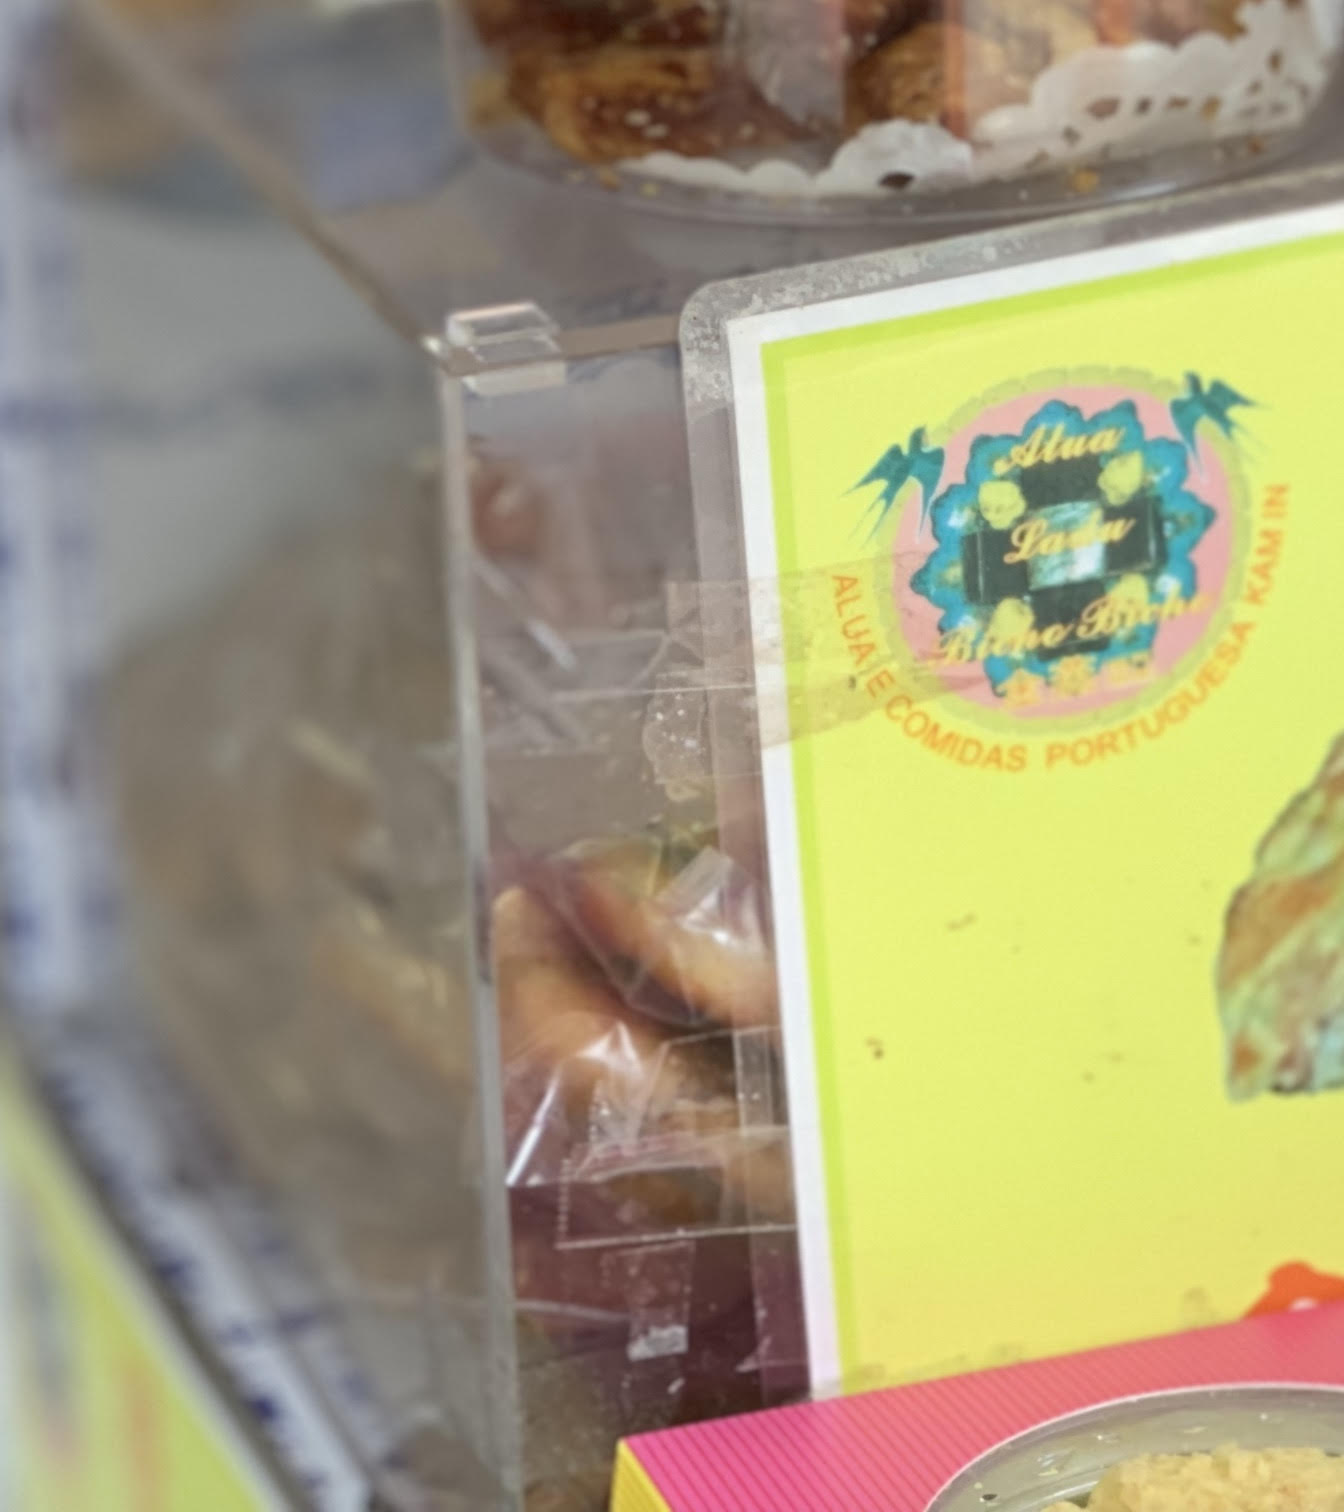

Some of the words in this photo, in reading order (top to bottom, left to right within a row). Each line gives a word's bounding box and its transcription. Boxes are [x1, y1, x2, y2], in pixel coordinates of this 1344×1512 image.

[1260, 483, 1291, 520] IN
[1243, 529, 1286, 607] KAM
[832, 574, 877, 667] ALUA
[866, 668, 896, 699] E
[1045, 621, 1256, 771] PORTUGUESA
[885, 694, 1027, 773] COMIDAS
